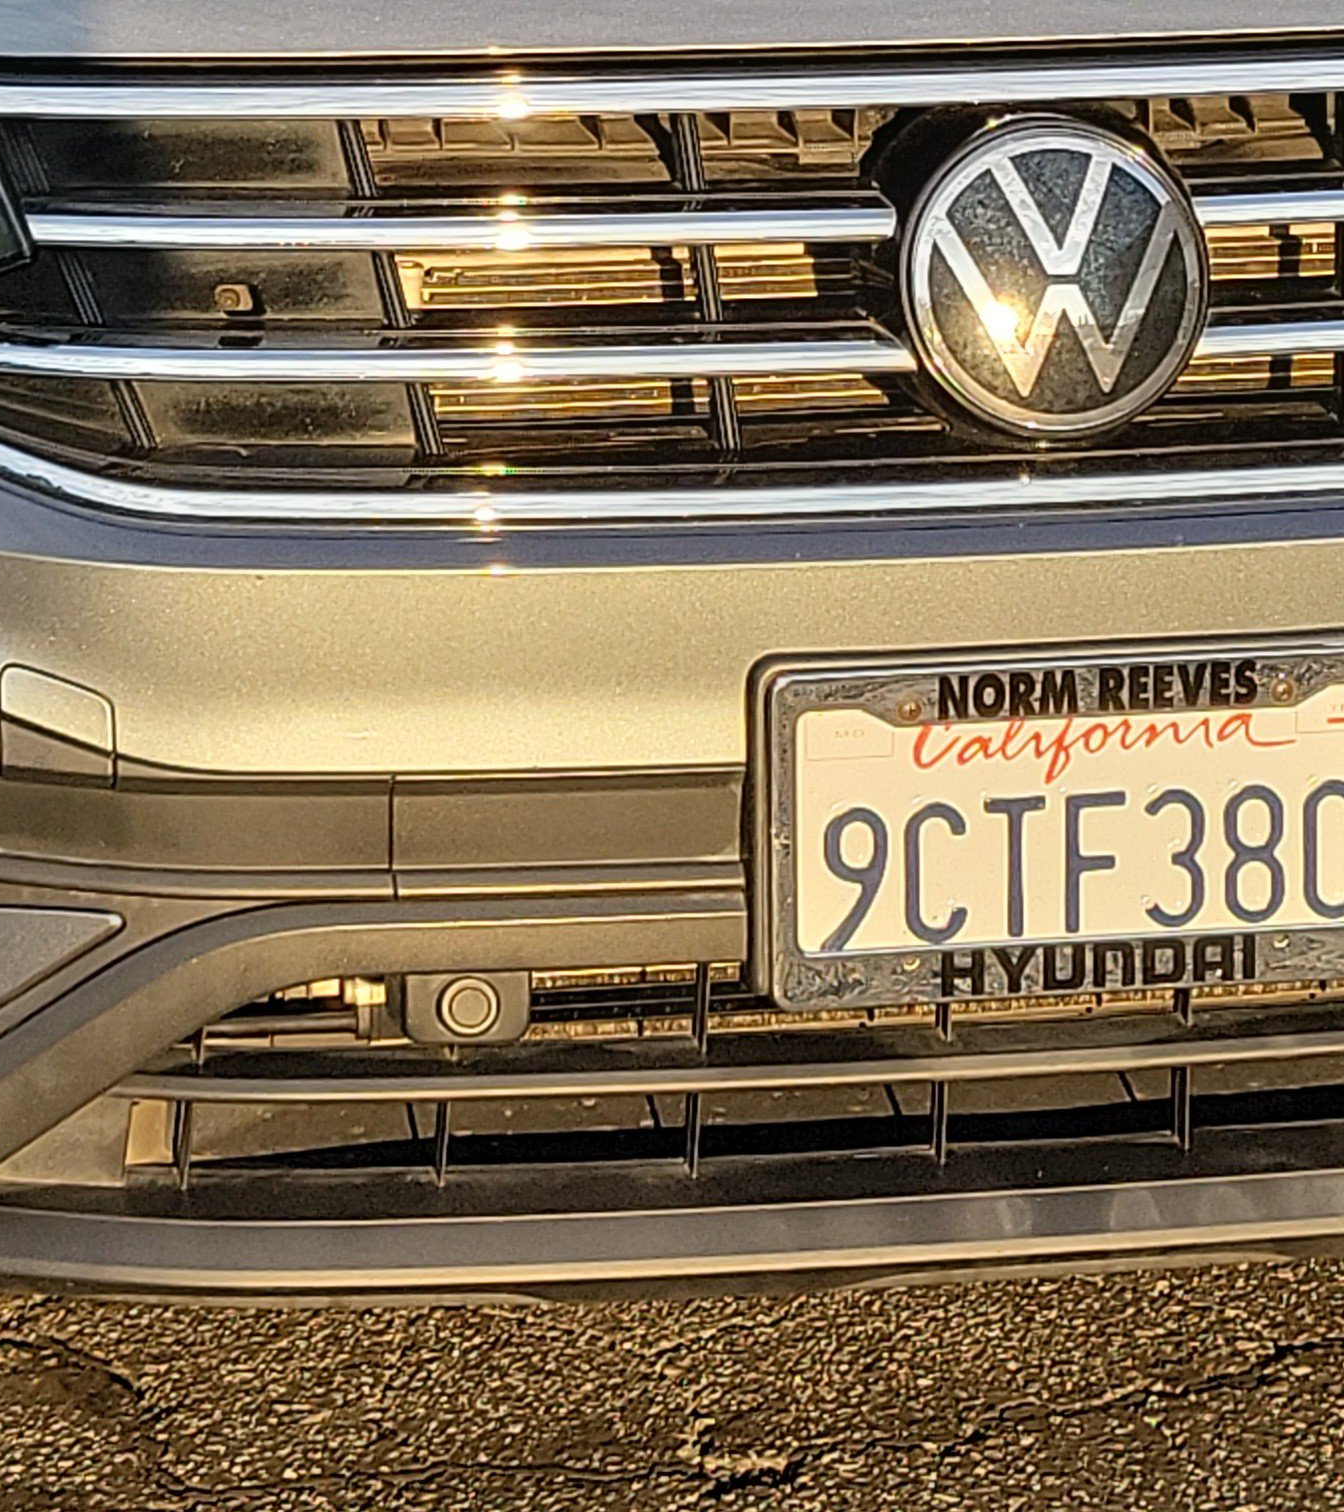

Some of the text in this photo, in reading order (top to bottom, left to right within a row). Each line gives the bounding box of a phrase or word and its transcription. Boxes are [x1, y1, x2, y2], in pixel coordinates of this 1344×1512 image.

[936, 659, 1259, 721] NORM REEVES
[912, 713, 1297, 785] California
[938, 933, 1256, 998] HYUNDAI
